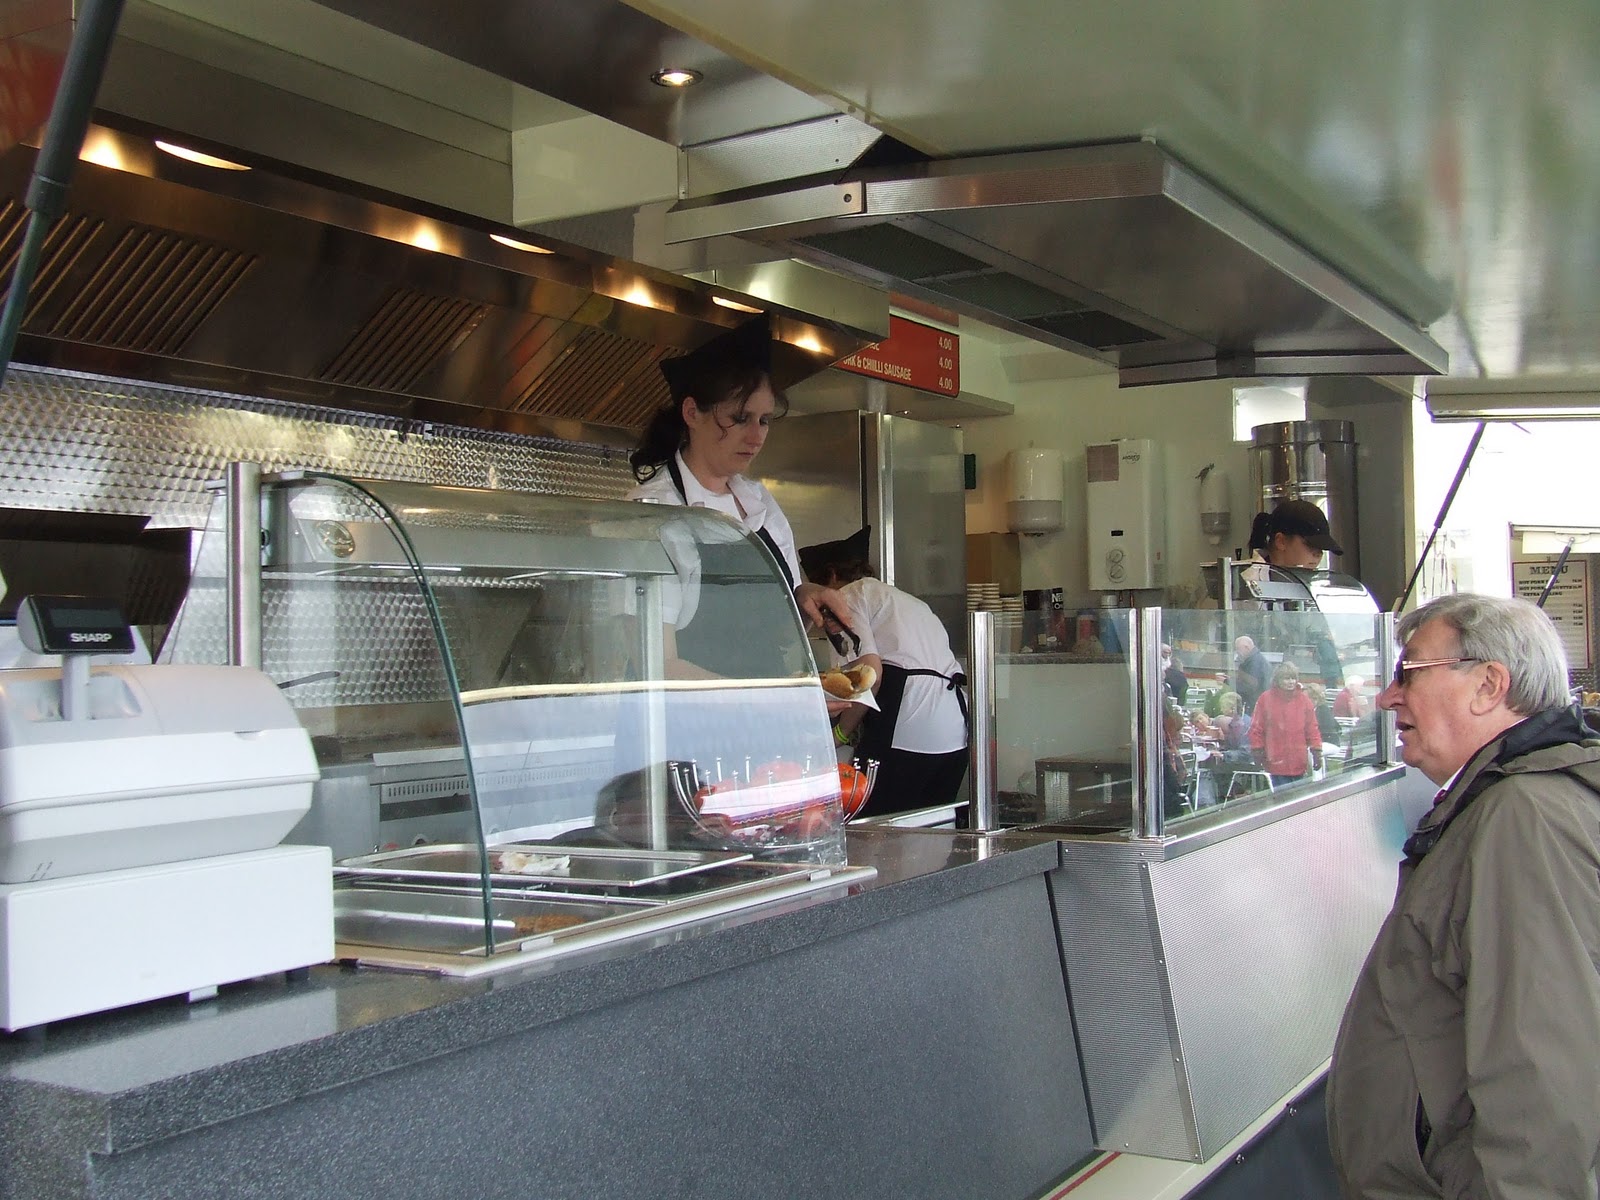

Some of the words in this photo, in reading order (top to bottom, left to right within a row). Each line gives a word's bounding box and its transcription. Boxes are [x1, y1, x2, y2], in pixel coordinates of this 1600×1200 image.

[938, 336, 952, 351] 4.00
[884, 362, 912, 381] SAUSAGE
[938, 356, 952, 371] 4.00
[938, 376, 953, 391] 4.00
[70, 632, 112, 643] SHARP
